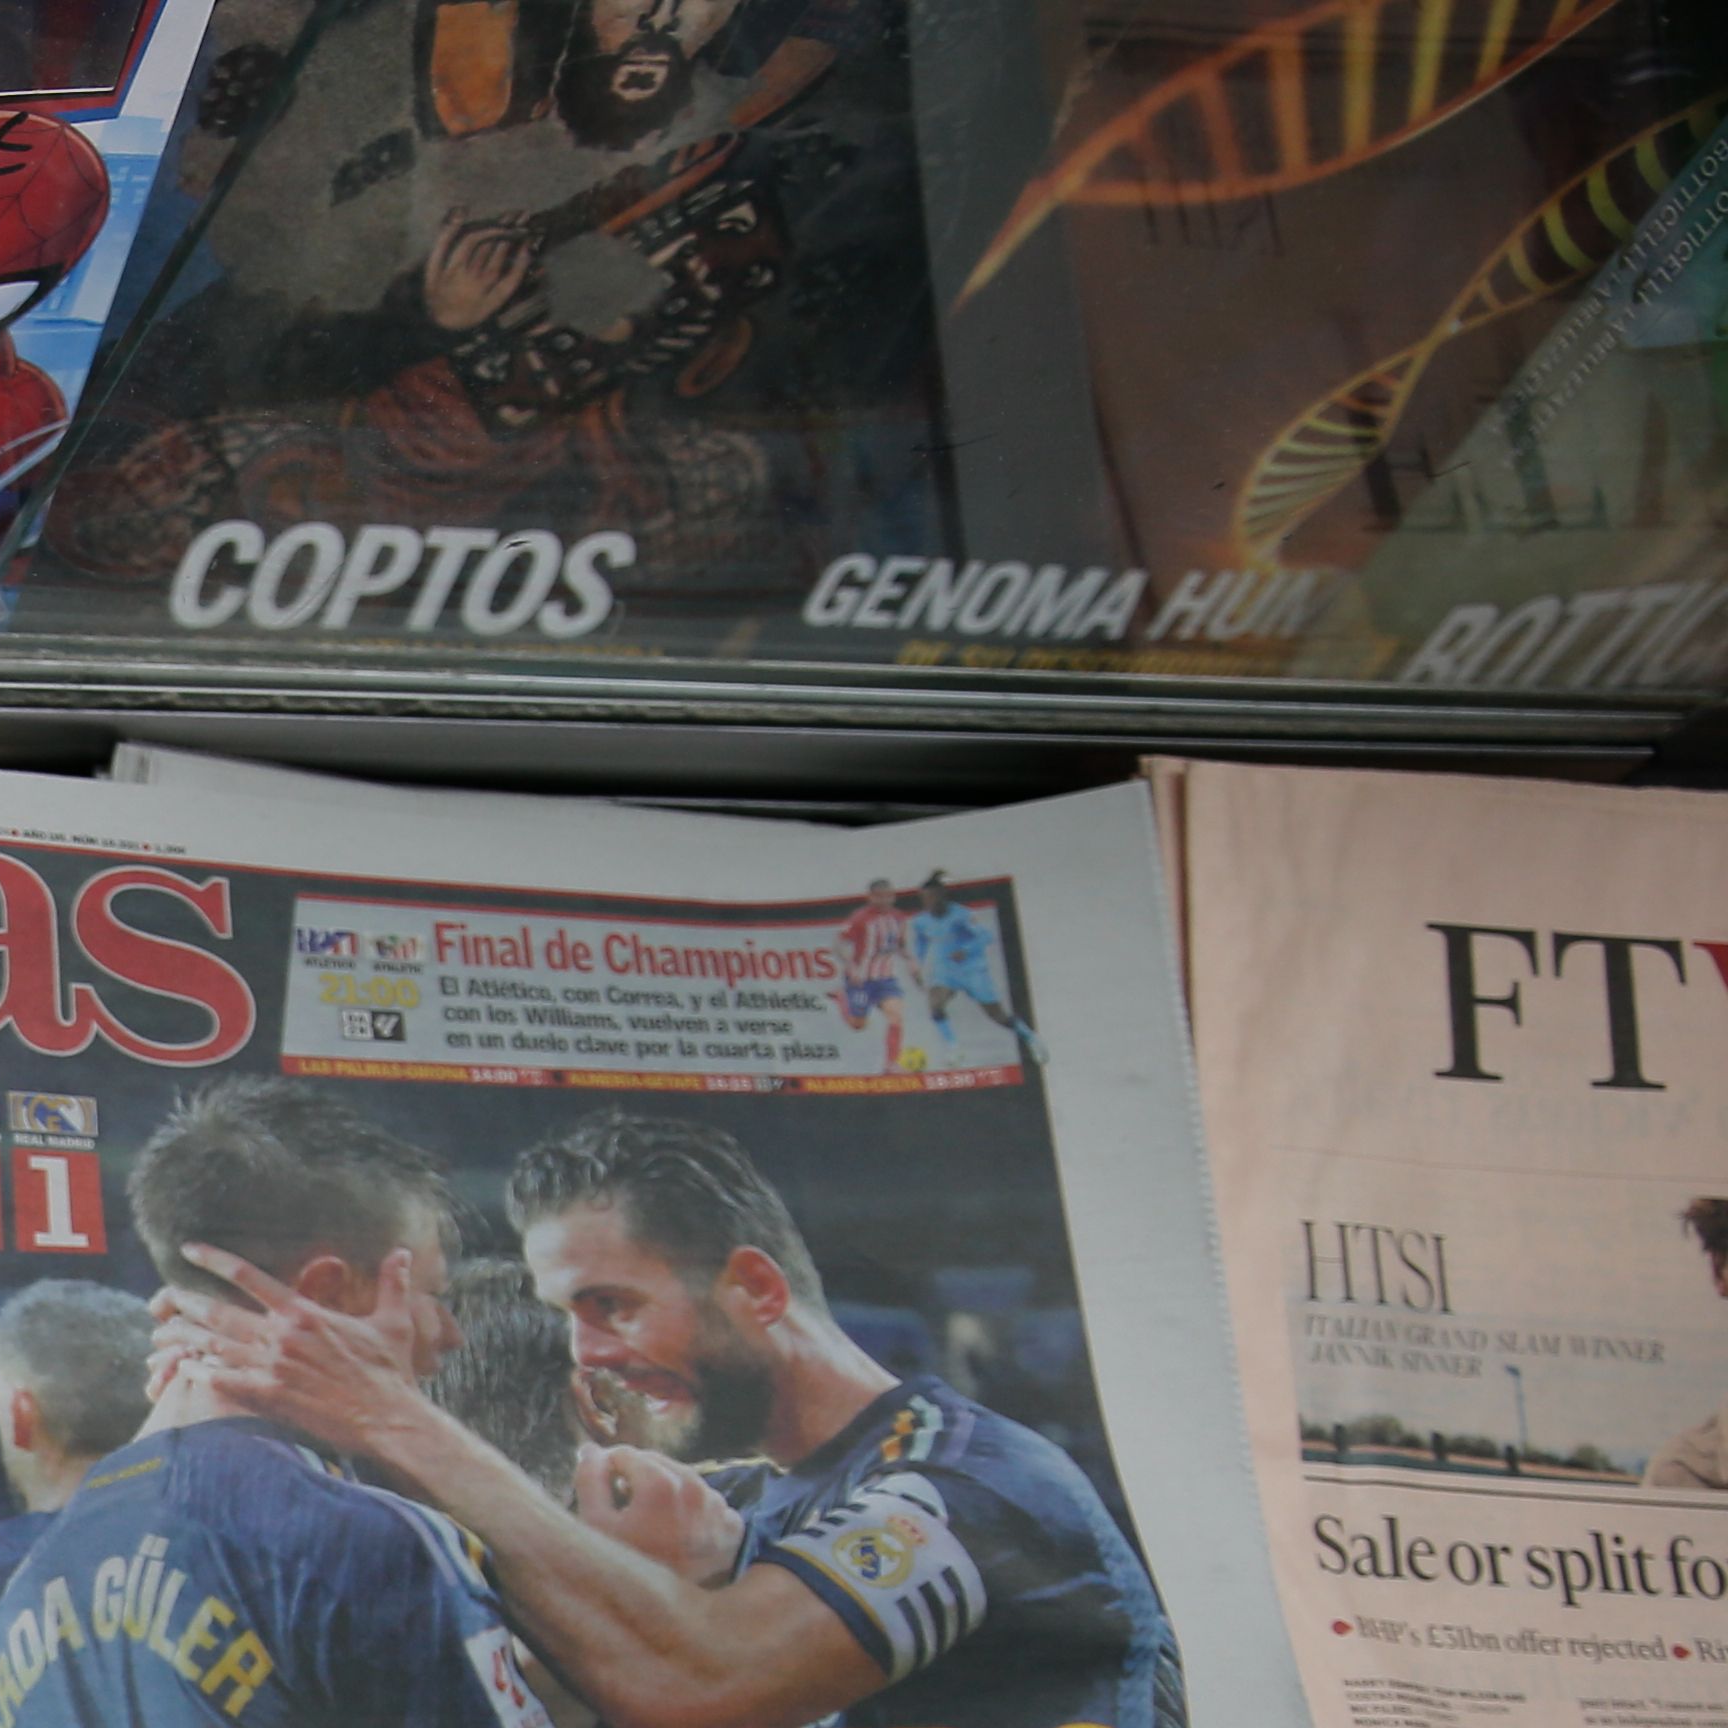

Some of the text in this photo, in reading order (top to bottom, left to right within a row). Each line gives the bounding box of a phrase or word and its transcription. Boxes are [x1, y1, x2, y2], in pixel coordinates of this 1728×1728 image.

[169, 518, 636, 641] COPTOS
[803, 553, 1150, 641] GENOMA
[433, 921, 838, 986] Final de Champions
[28, 1154, 89, 1247] 1
[1299, 1219, 1454, 1316] HTSI
[1313, 1513, 1439, 1584] Sale
[1446, 1541, 1513, 1588] or
[1525, 1529, 1669, 1617] split
